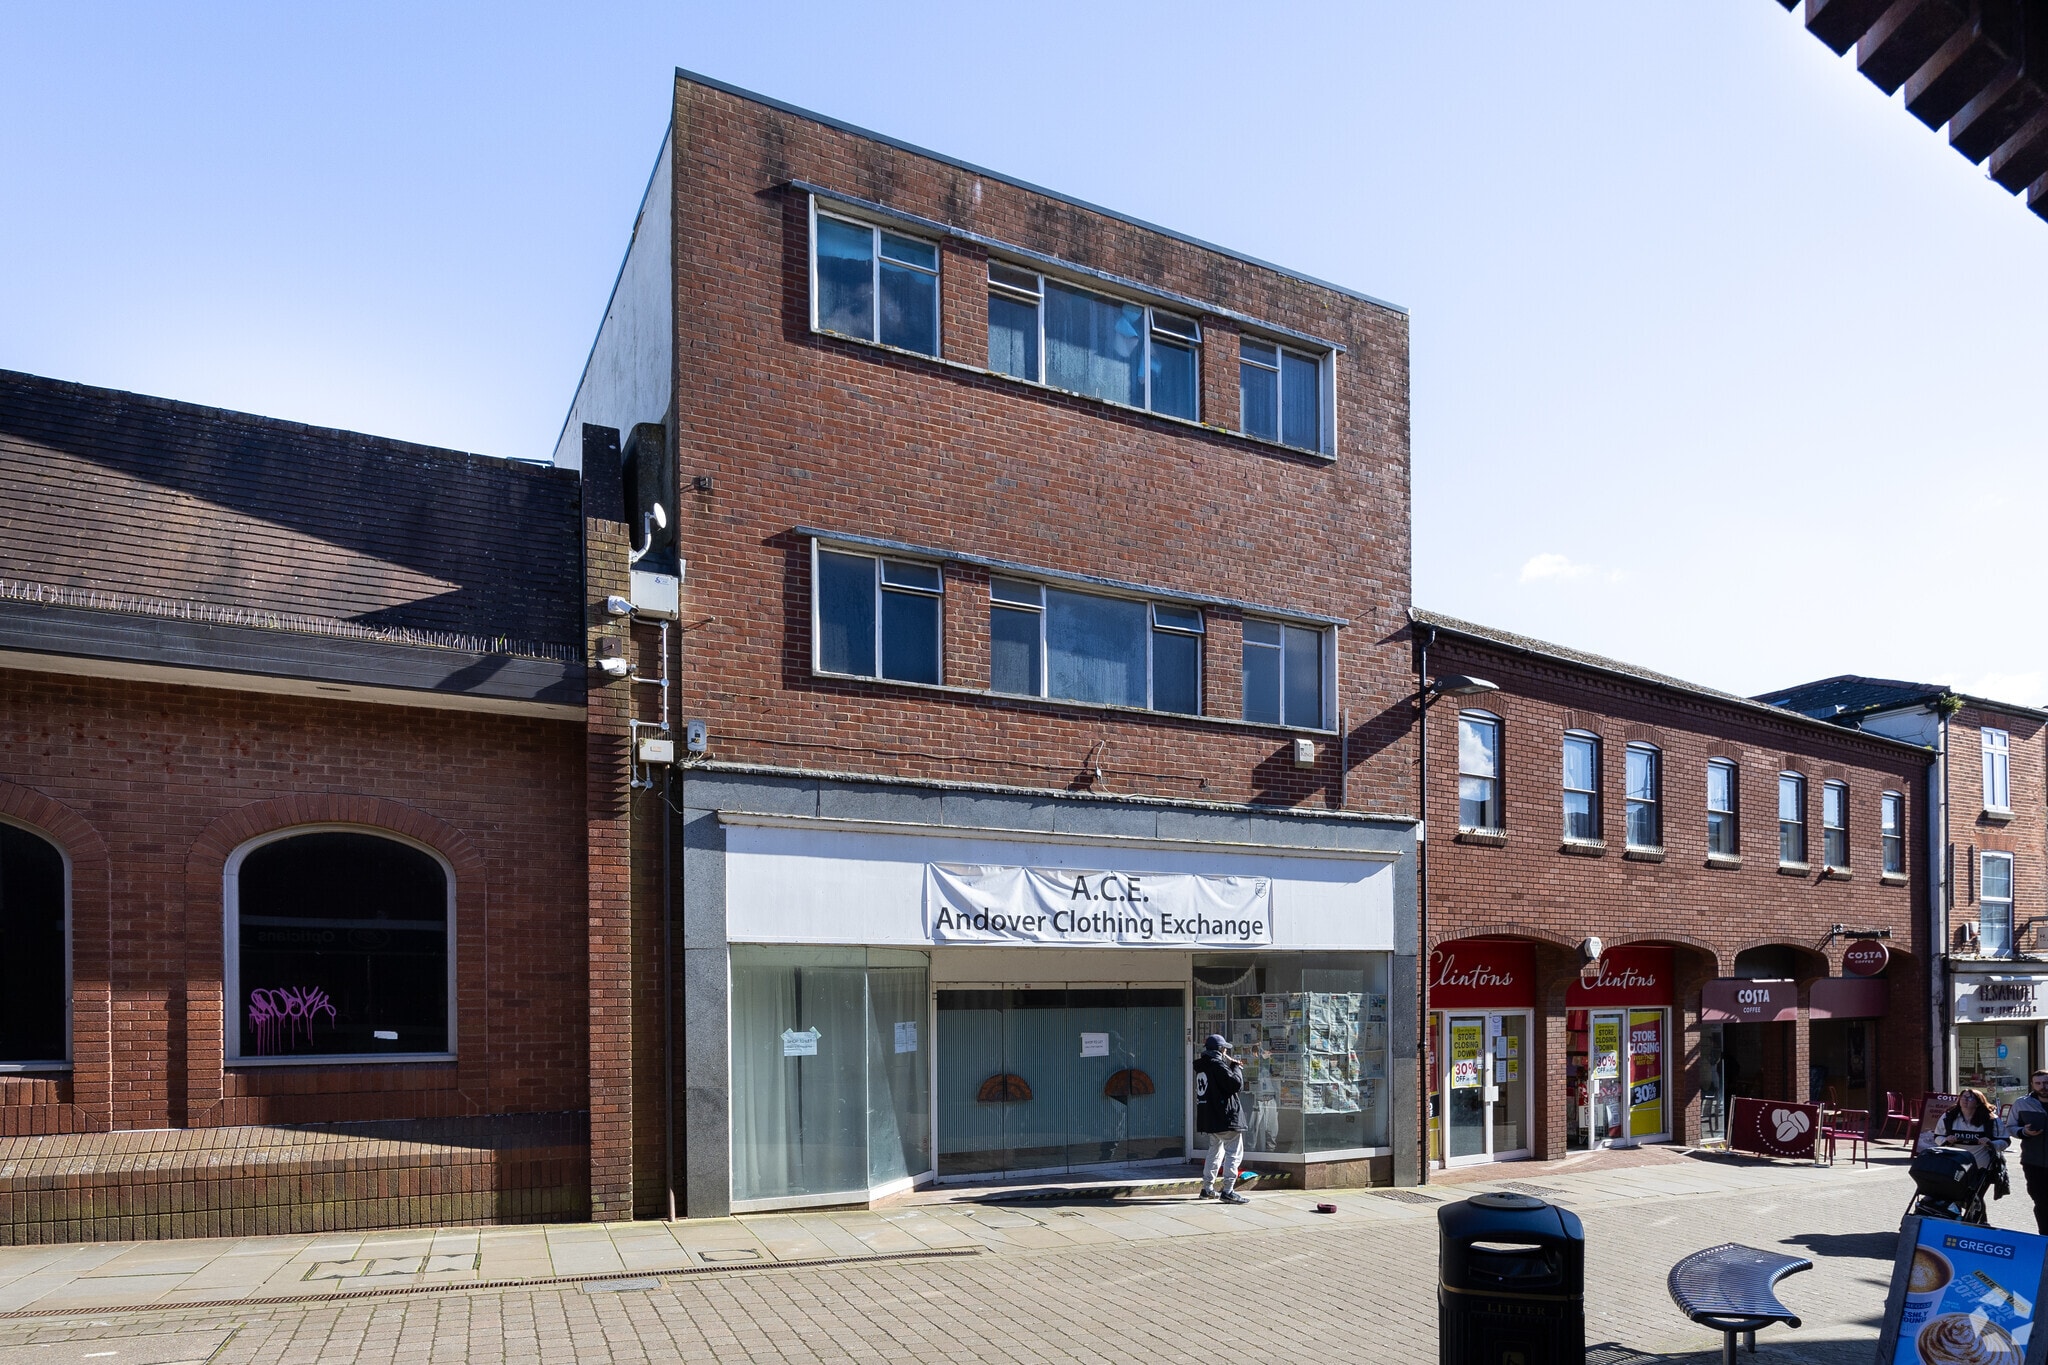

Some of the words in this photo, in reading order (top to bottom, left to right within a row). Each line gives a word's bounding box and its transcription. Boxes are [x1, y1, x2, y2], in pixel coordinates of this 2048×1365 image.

[1071, 875, 1149, 902] A.C.E.
[936, 907, 1046, 932] Andover
[1053, 910, 1154, 940] Clothing
[1161, 913, 1263, 941] Exchange
[1847, 951, 1882, 960] COSTA
[1737, 989, 1770, 1004] COSTA
[1631, 1030, 1657, 1042] STORE
[1454, 1041, 1479, 1049] CLOSING
[1630, 1041, 1660, 1054] CLOSING
[1457, 1049, 1476, 1057] DOWN
[1596, 1056, 1616, 1067] 30%
[1455, 1062, 1478, 1075] 30%
[1634, 1082, 1656, 1104] 30%
[1937, 1094, 1958, 1102] COST
[1959, 1239, 2012, 1257] GREGGS
[1487, 1303, 1546, 1316] LITTER
